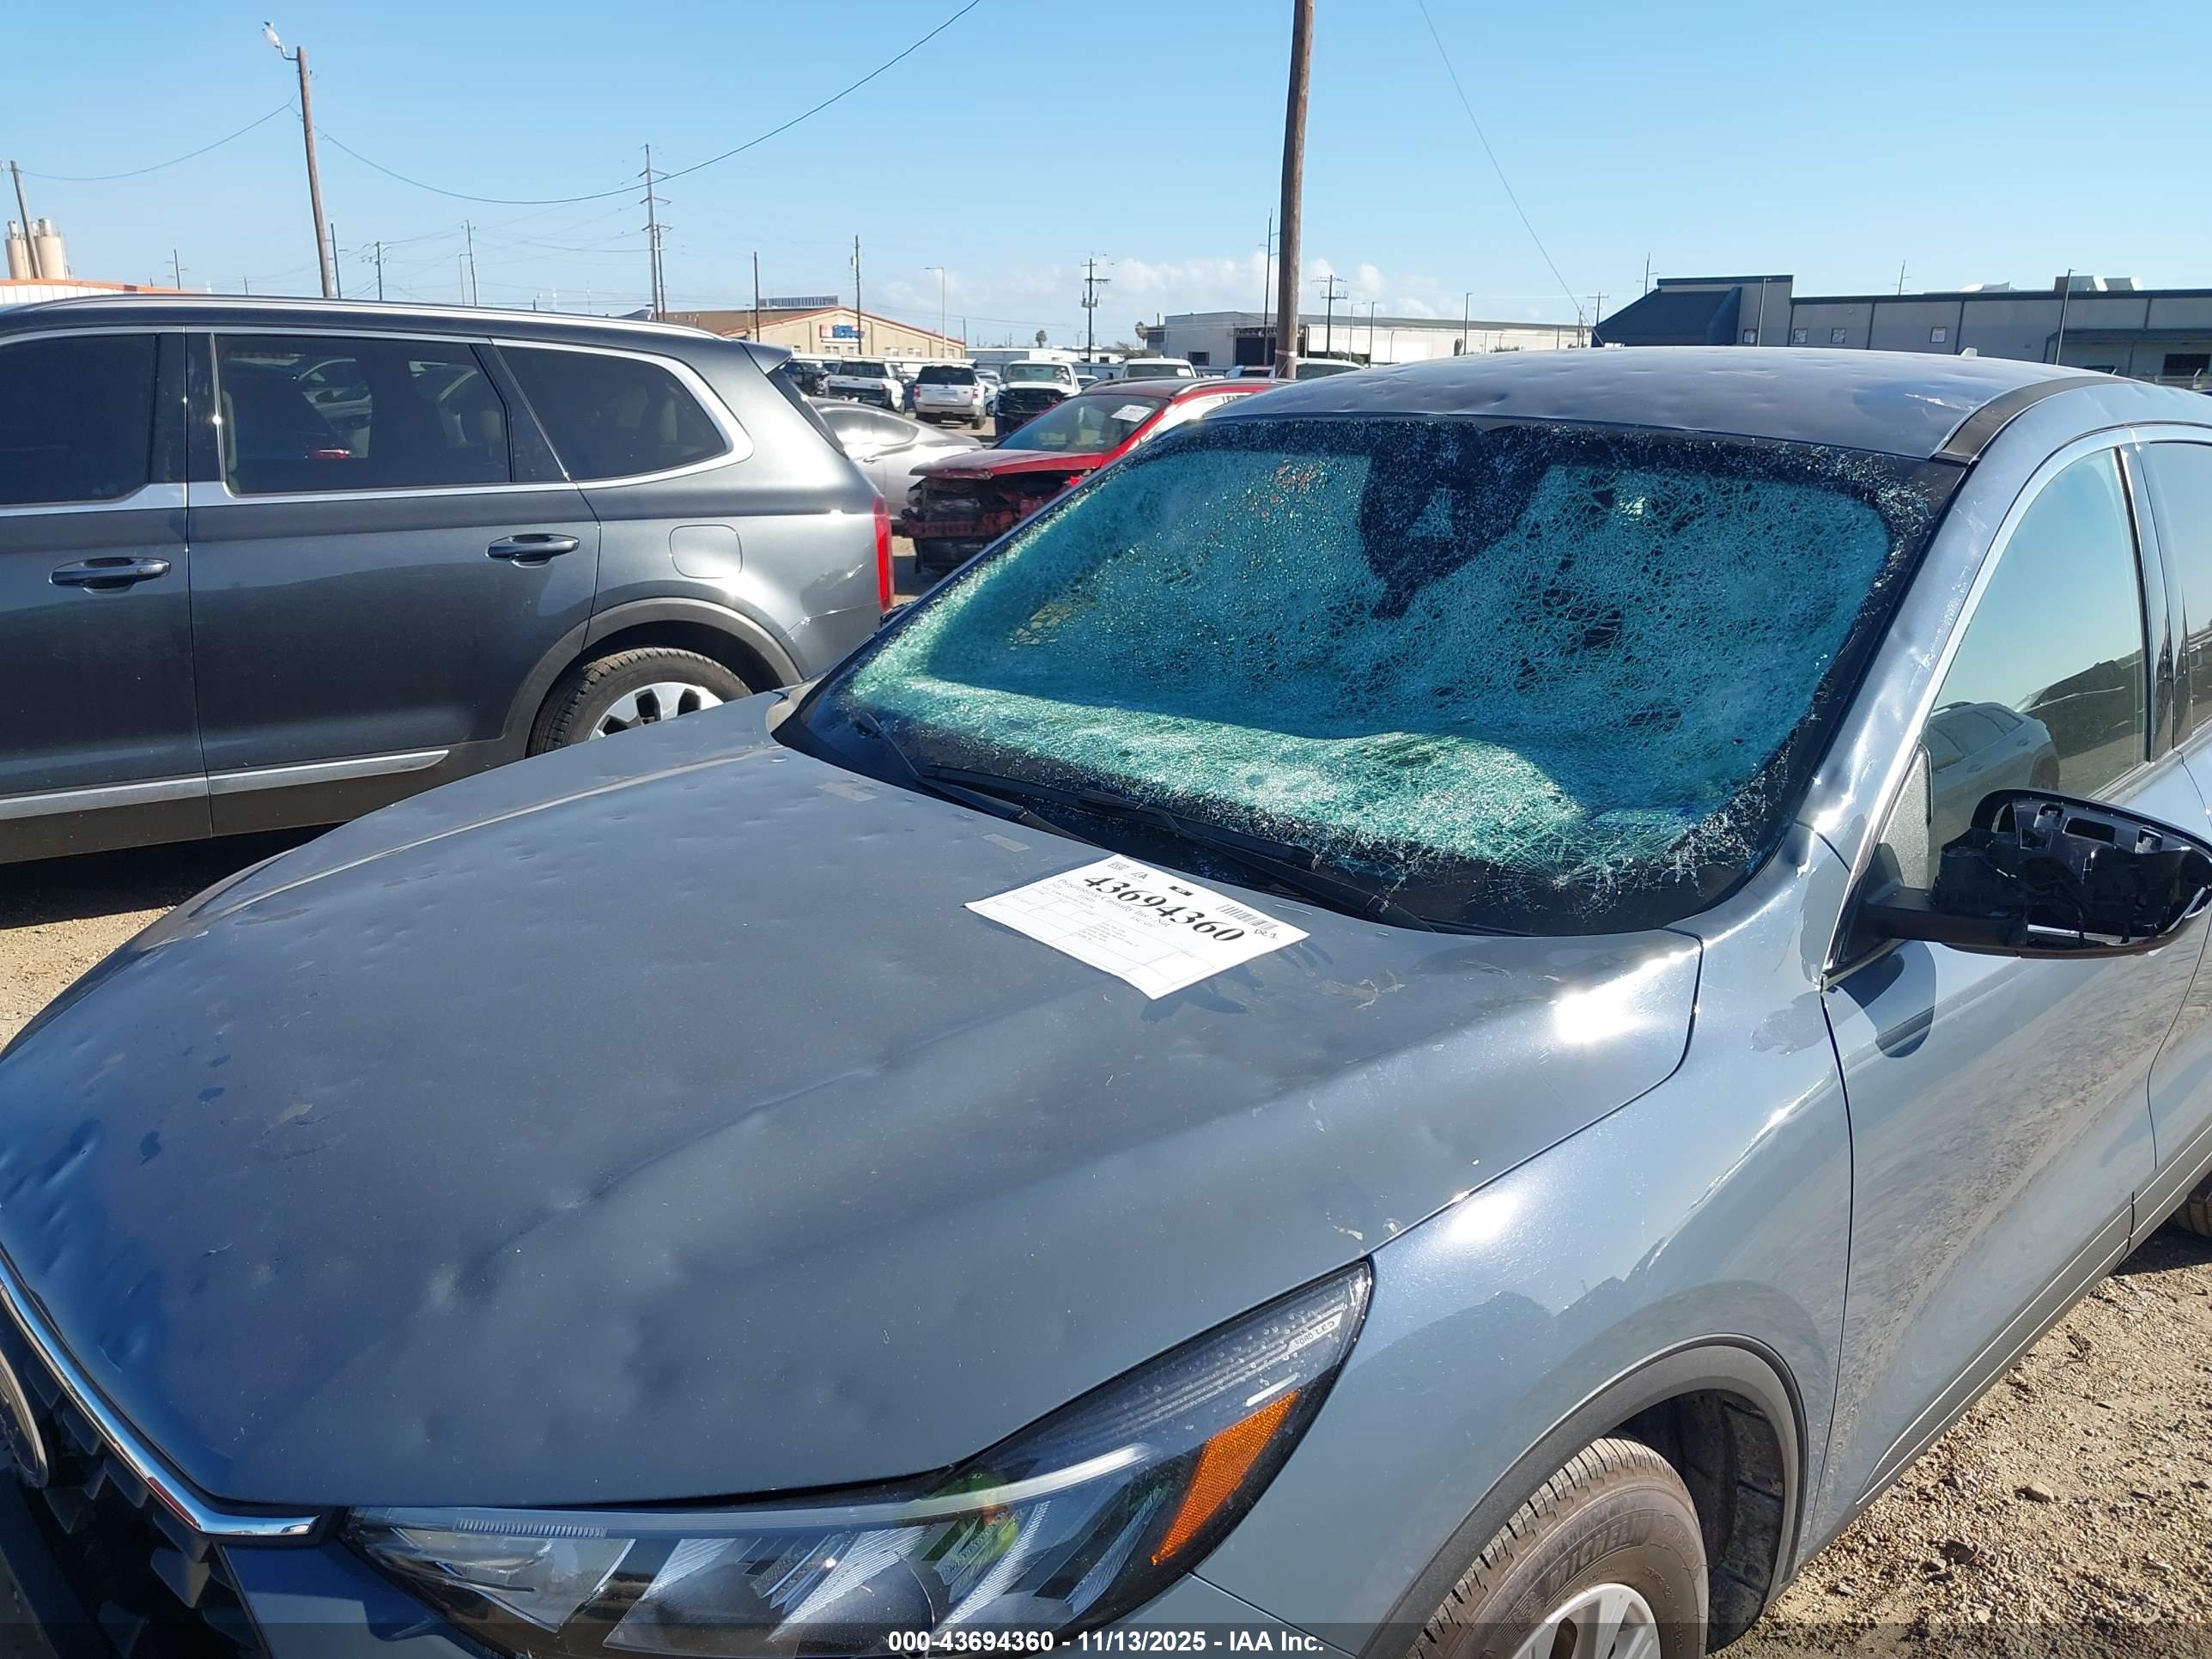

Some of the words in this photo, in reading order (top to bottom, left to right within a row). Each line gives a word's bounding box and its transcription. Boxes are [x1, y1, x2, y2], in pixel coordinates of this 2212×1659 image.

[1057, 878, 1101, 898] Progressive
[1101, 896, 1133, 912] Casualty
[1084, 877, 1245, 941] 43694360
